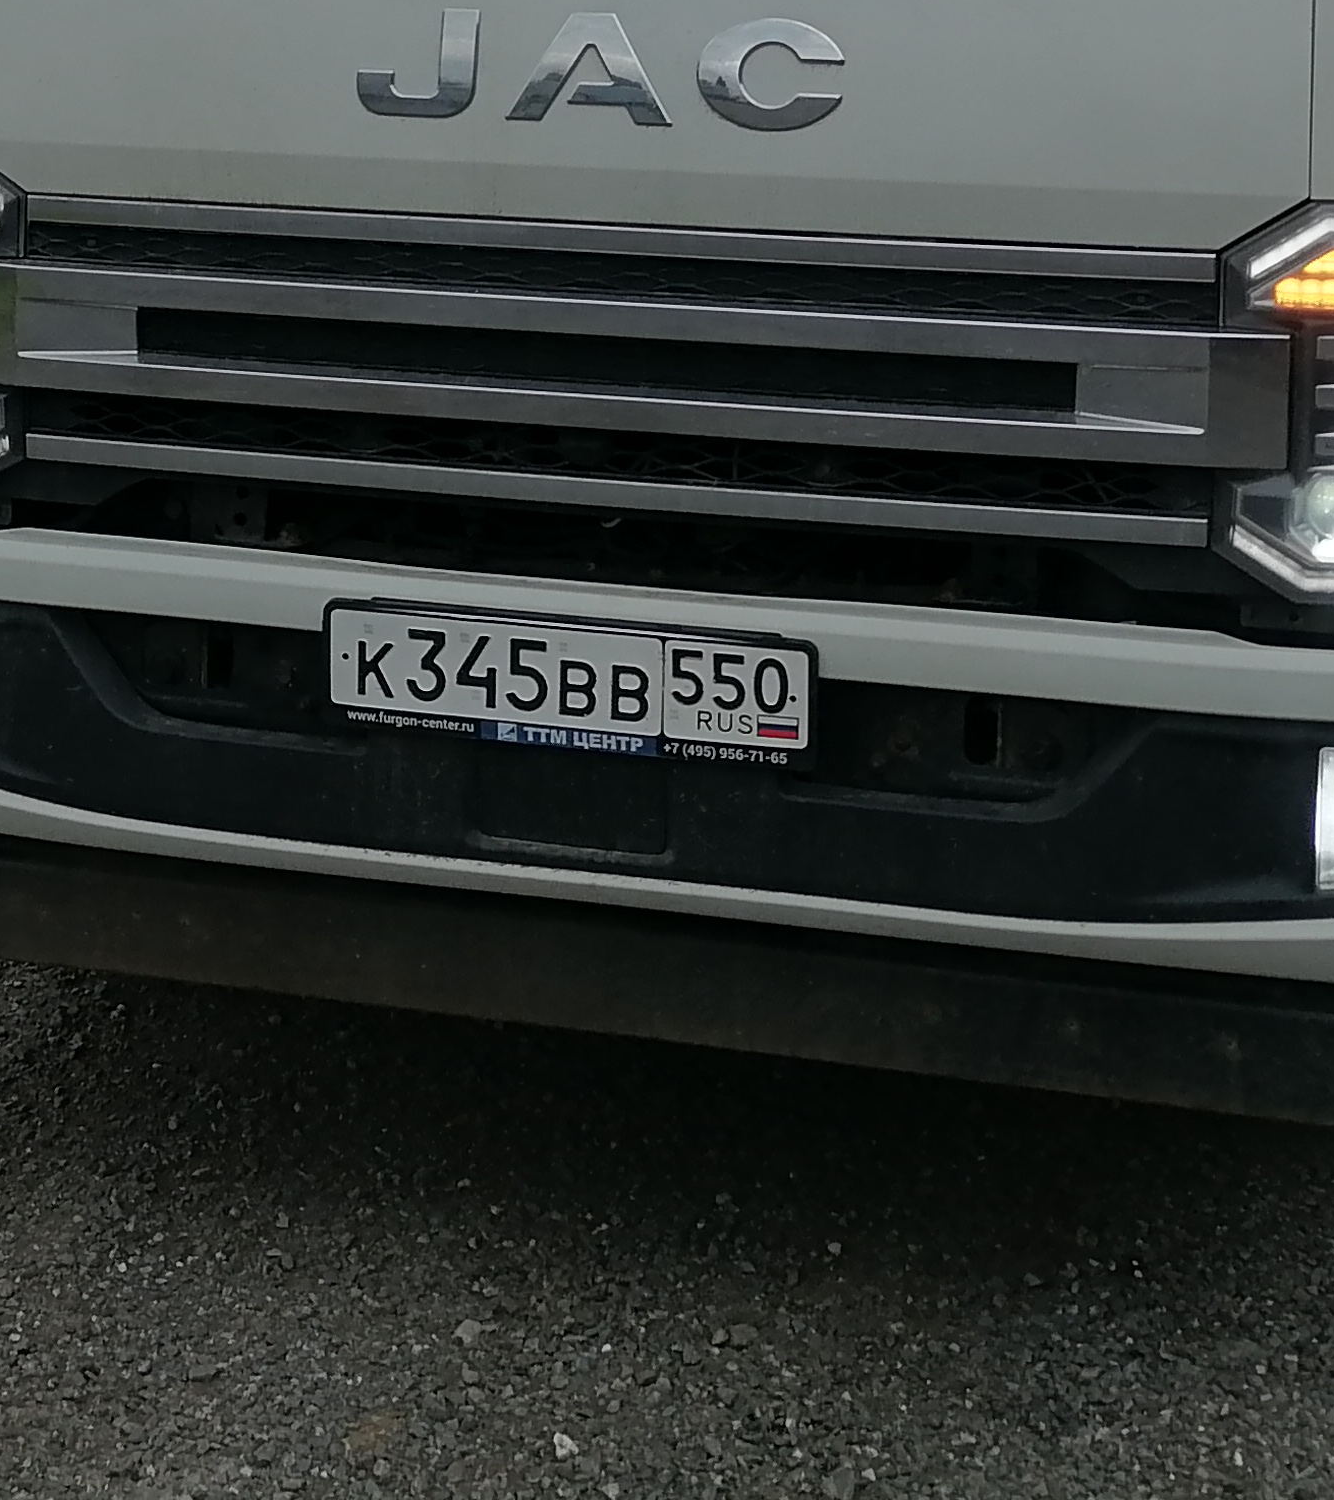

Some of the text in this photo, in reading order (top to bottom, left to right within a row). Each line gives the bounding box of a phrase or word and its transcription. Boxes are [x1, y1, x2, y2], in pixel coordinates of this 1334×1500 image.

[356, 7, 846, 132] JAC
[671, 647, 790, 714] 550
[347, 709, 475, 732] www.furgon-center.ru
[696, 710, 754, 735] RUS
[573, 730, 644, 752] ЦЕНТР
[663, 742, 788, 764] +7 (495) 956-71-65
